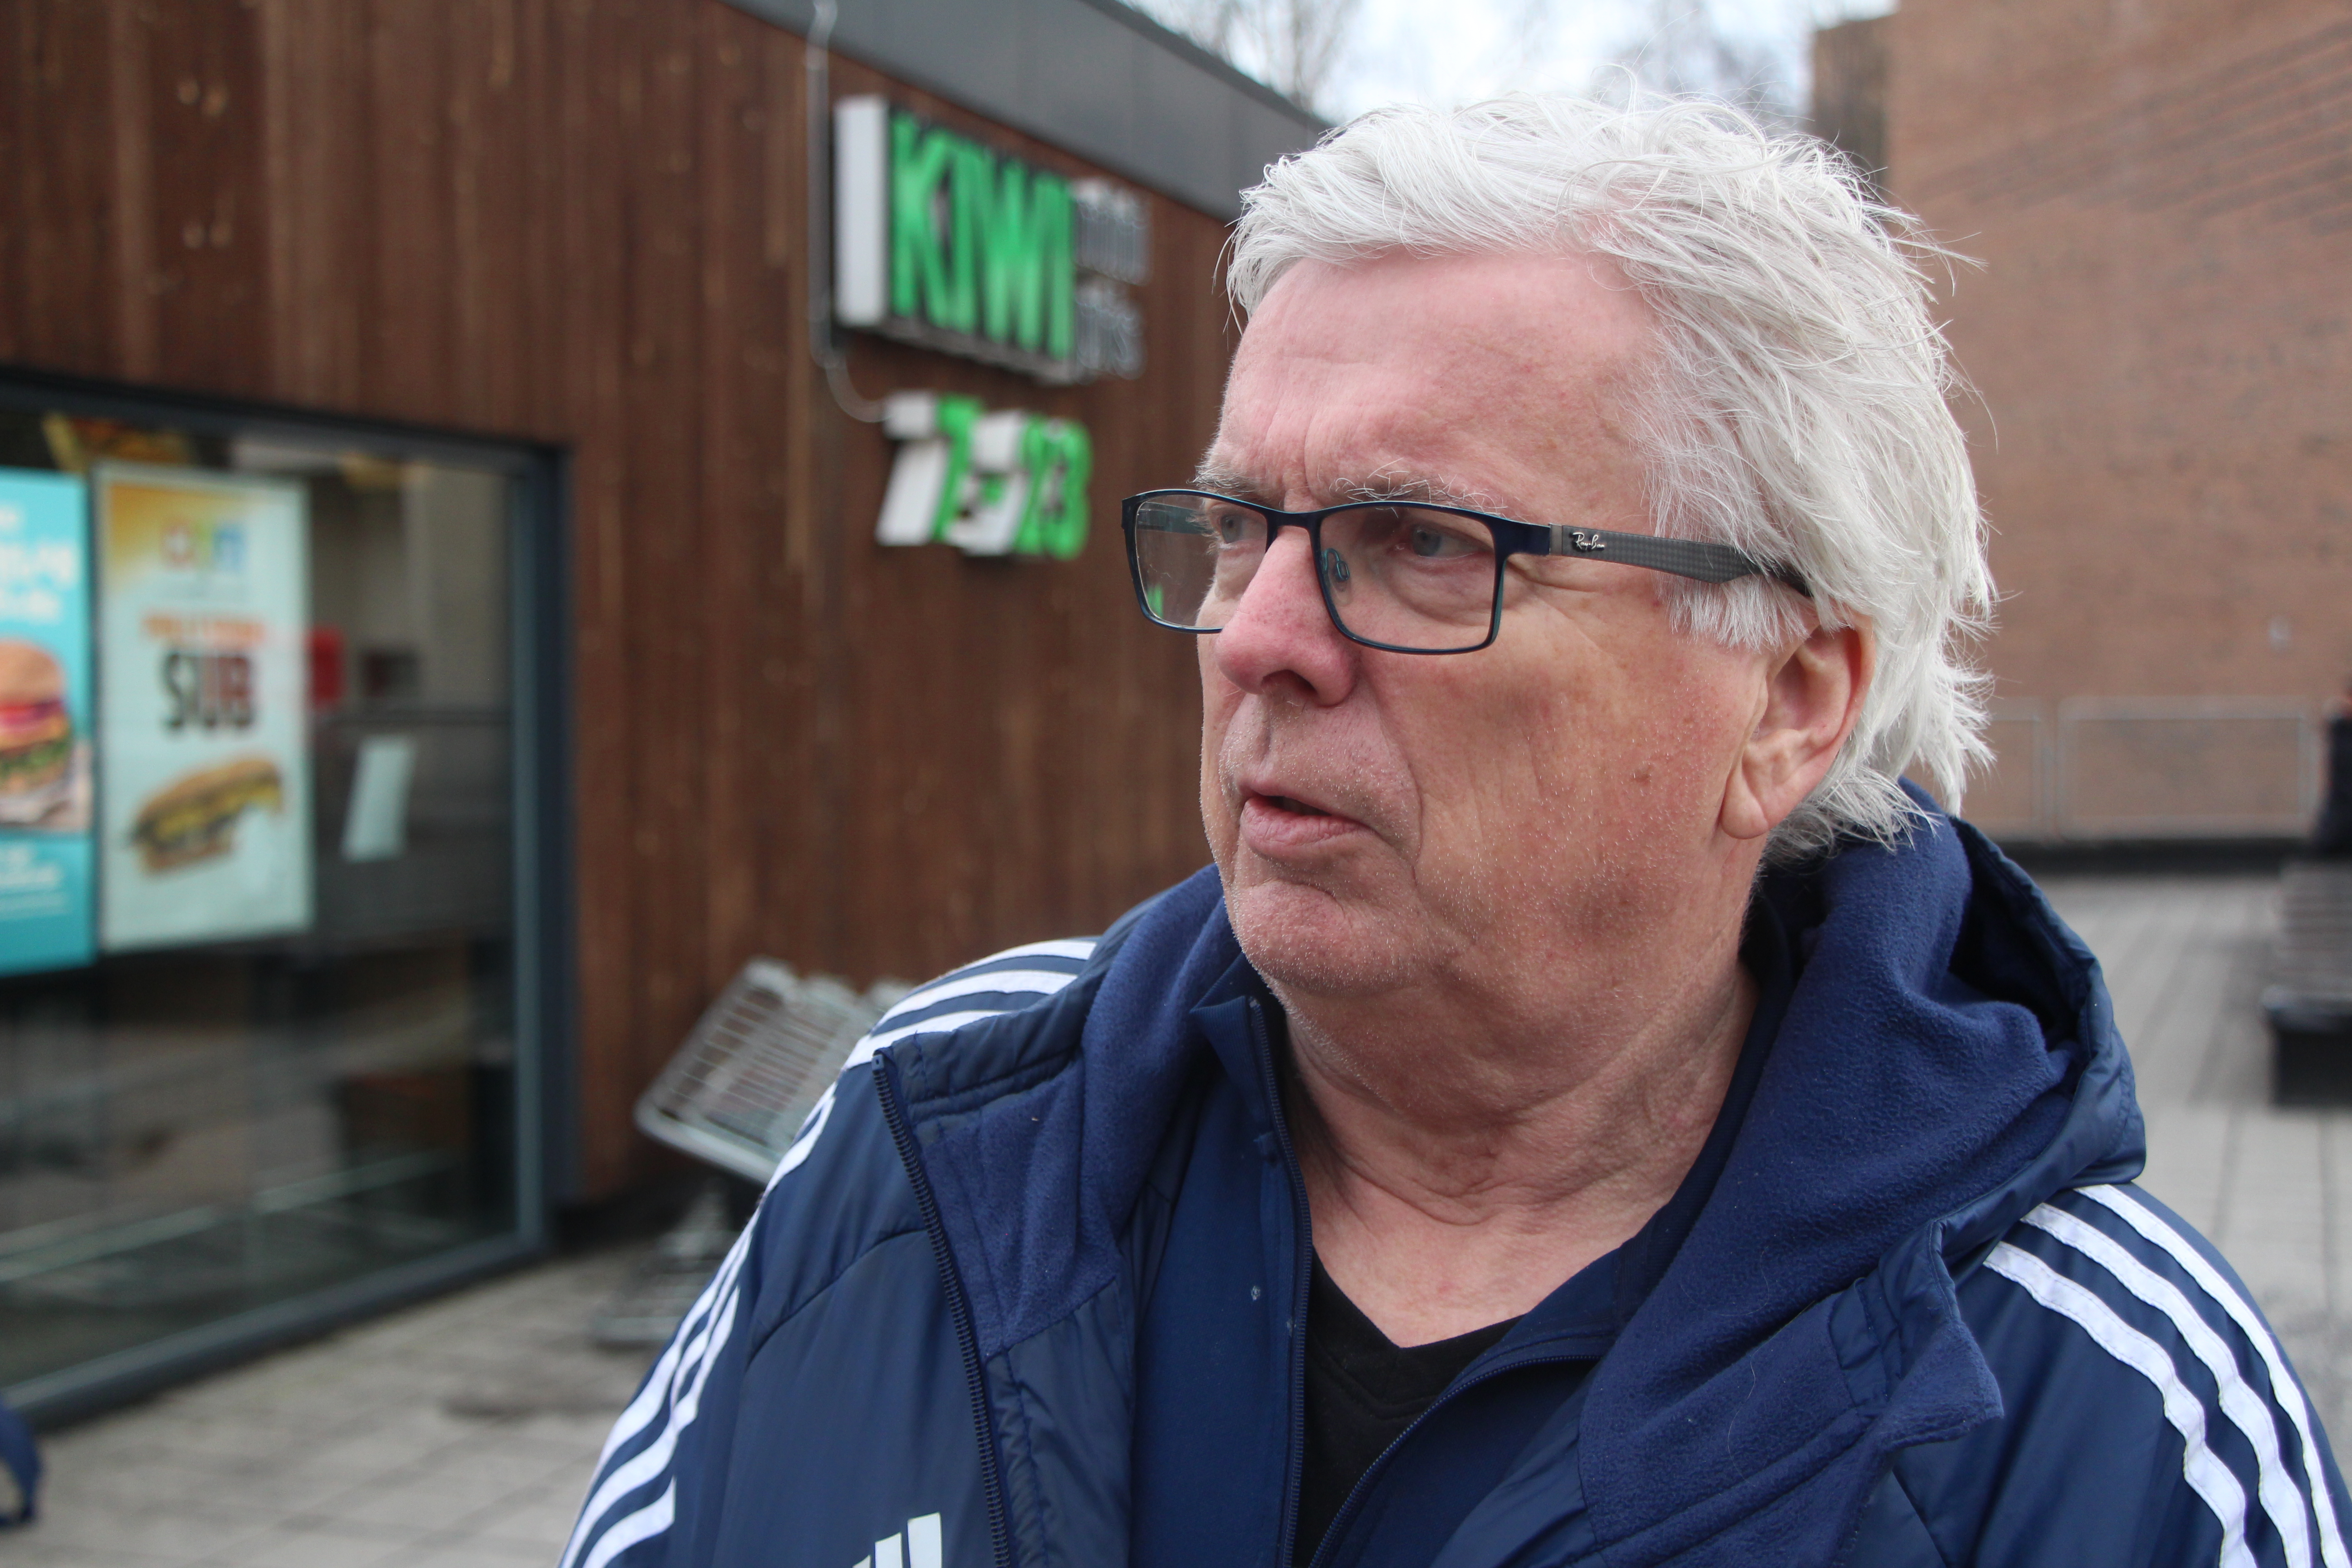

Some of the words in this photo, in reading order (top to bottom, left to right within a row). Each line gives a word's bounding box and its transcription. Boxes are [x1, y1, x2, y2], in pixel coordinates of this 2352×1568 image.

[889, 108, 1076, 361] KIWI
[926, 394, 1093, 561] 7-23
[161, 650, 256, 733] SUB
